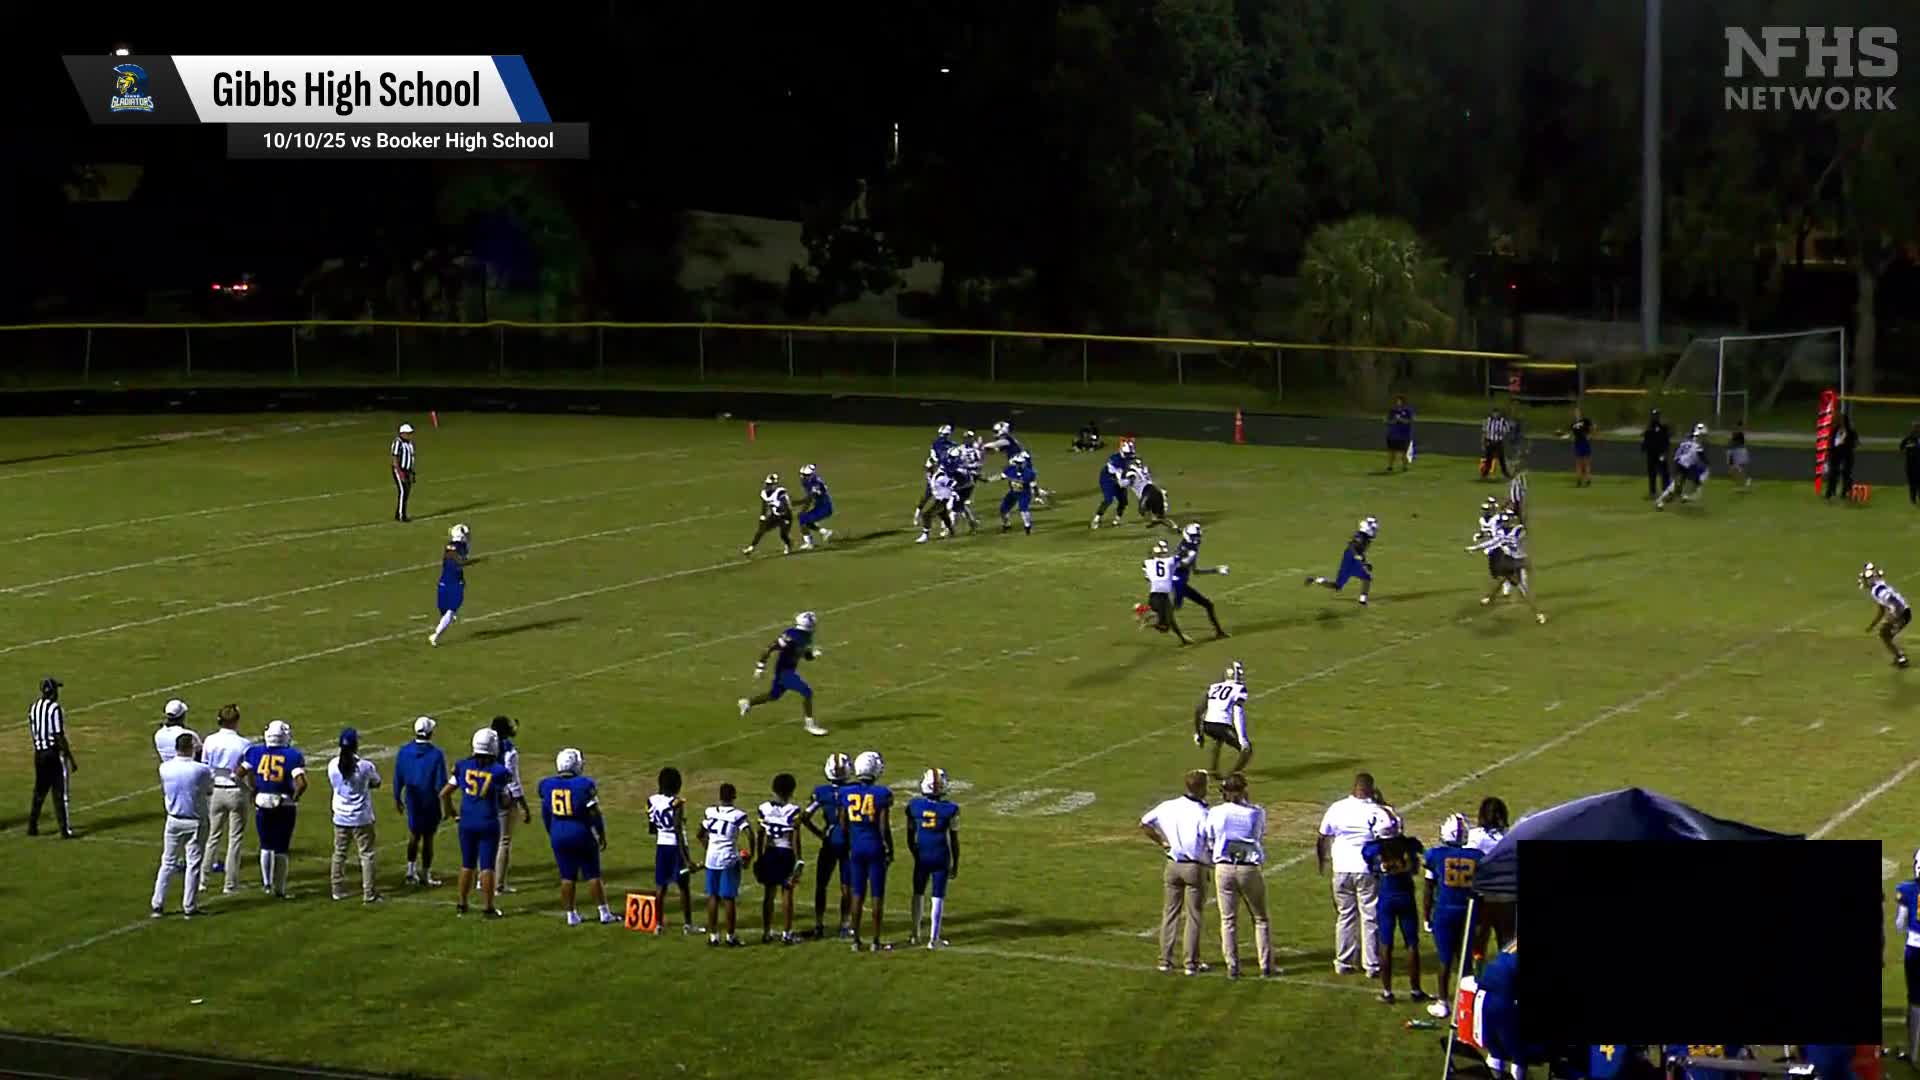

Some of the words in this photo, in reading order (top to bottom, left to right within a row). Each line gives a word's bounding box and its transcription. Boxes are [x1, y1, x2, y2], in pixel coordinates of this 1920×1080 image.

[1156, 561, 1166, 578] 6
[1210, 685, 1233, 701] 20
[257, 755, 285, 782] 45
[465, 769, 492, 796] 57
[552, 789, 573, 816] 61
[847, 793, 876, 823] 24
[922, 811, 937, 828] 3
[628, 898, 653, 929] 30
